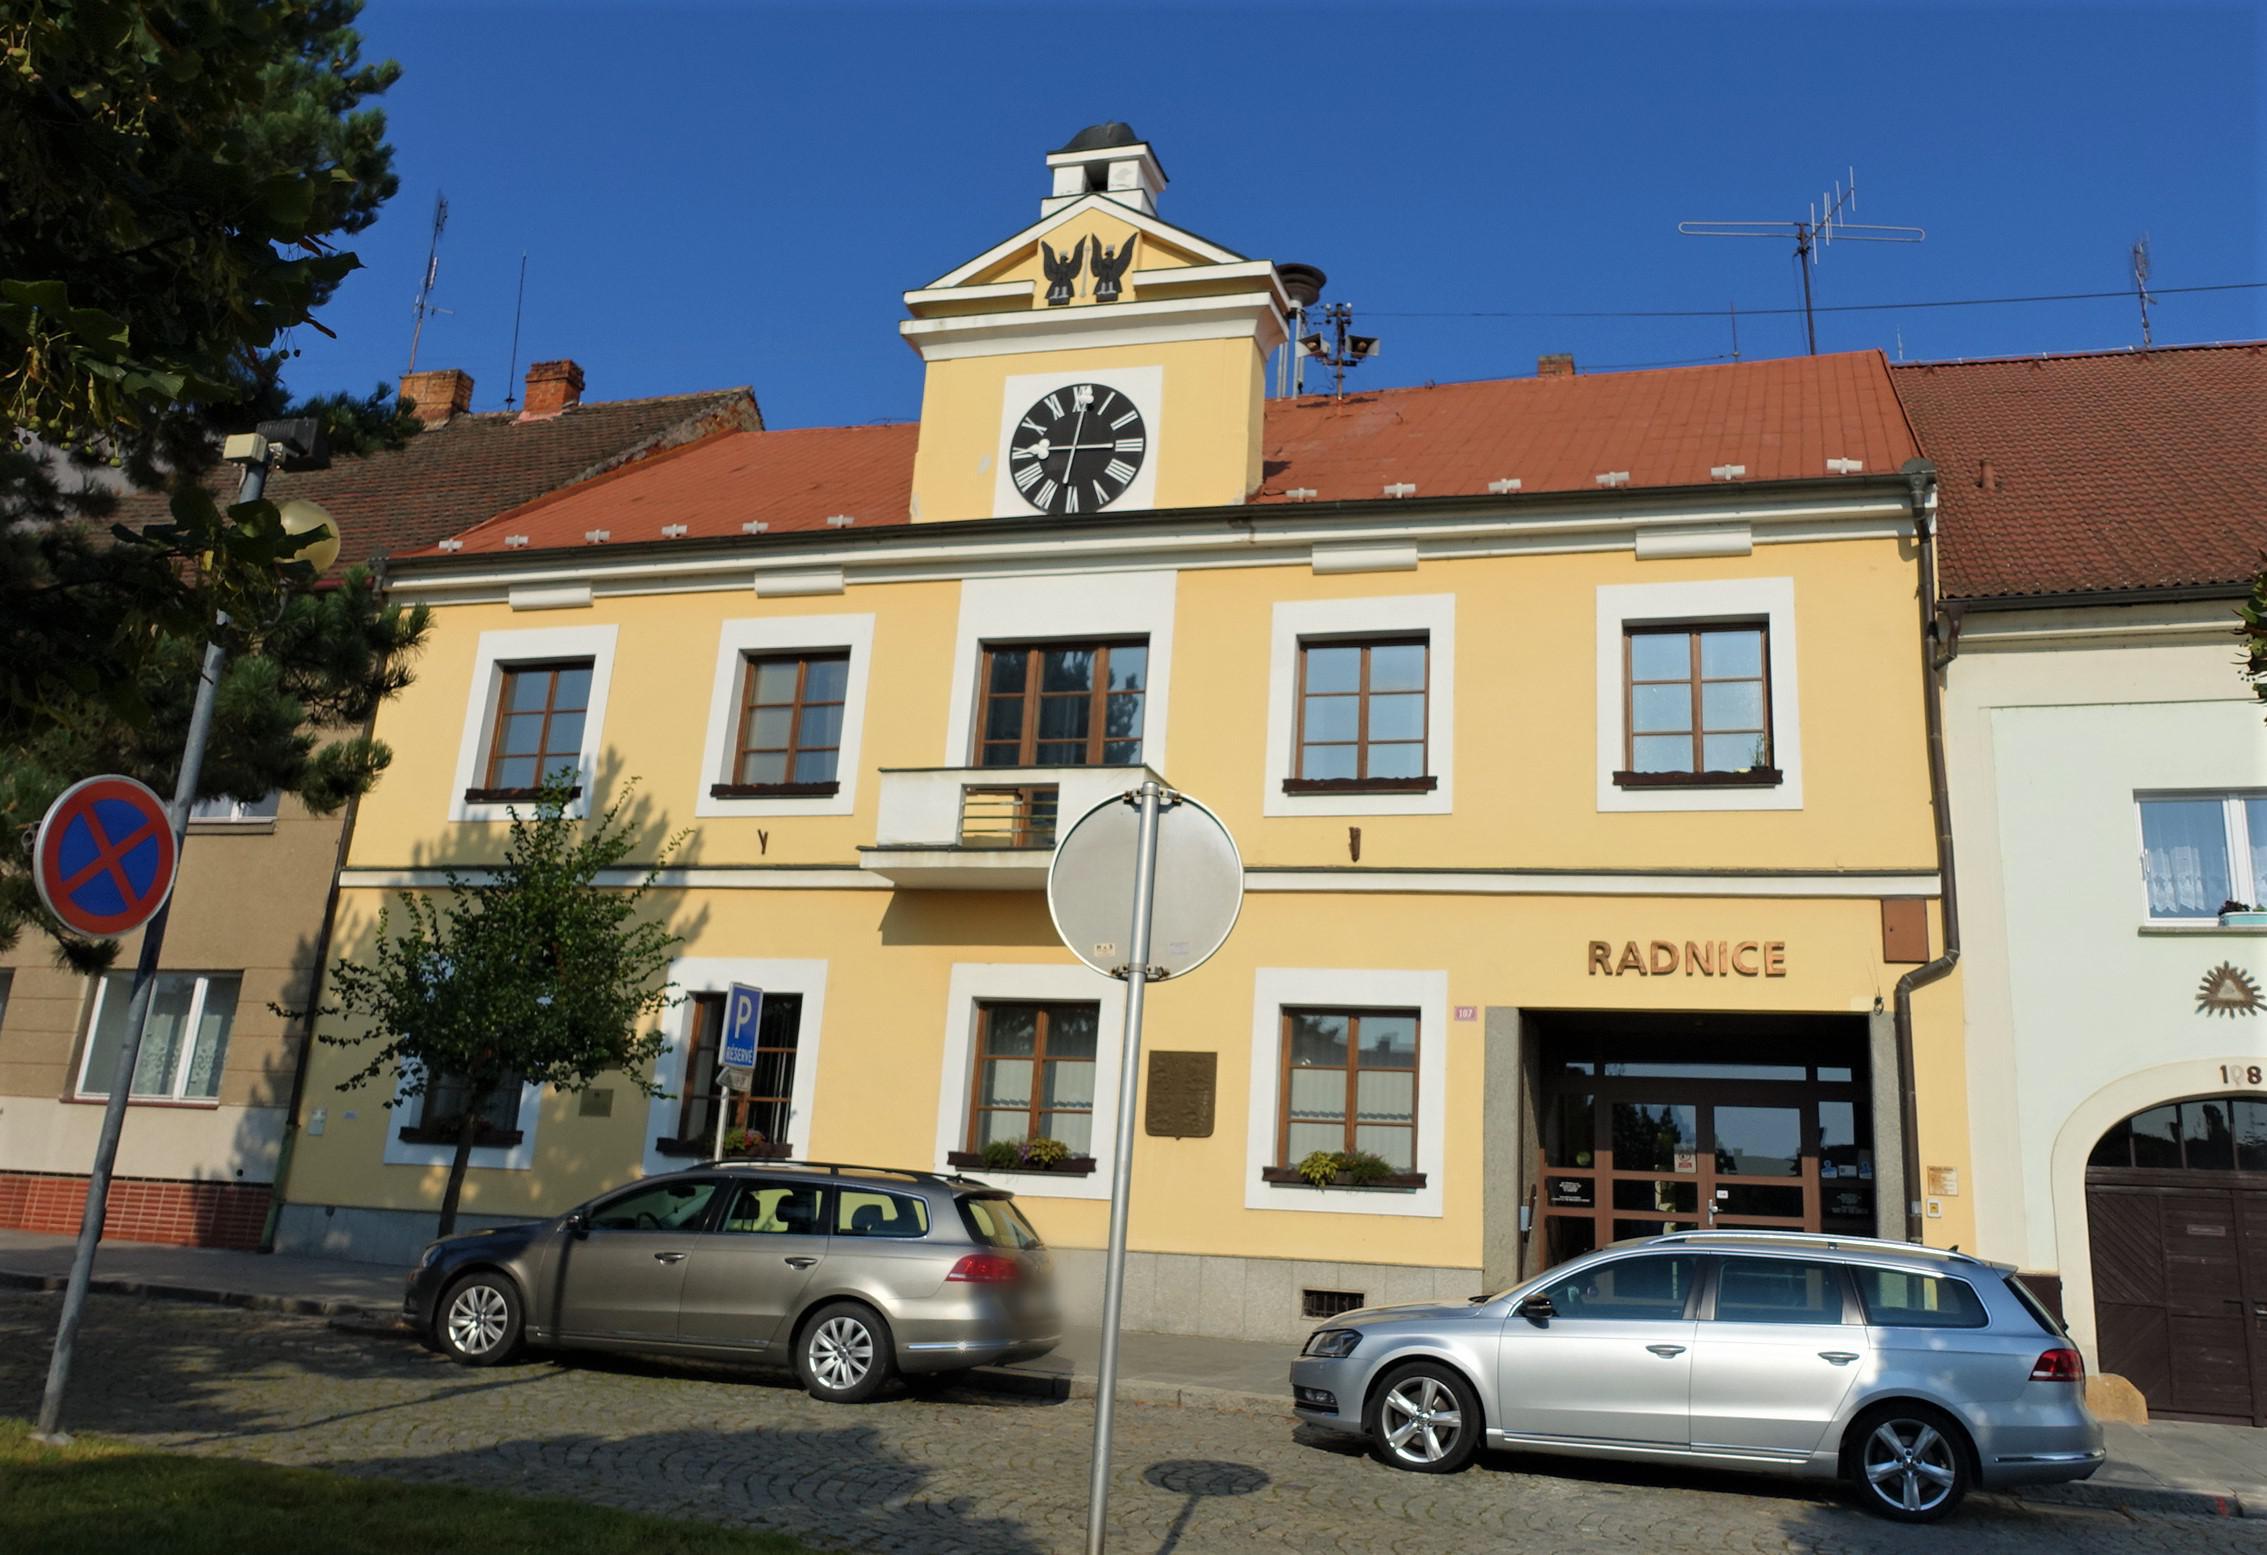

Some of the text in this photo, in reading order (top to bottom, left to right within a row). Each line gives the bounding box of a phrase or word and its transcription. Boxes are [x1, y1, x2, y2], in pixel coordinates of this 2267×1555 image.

[1044, 393, 1065, 420] XI
[1021, 416, 1047, 436] X
[1110, 410, 1138, 431] II
[1115, 438, 1143, 452] III
[1033, 479, 1058, 510] VII
[1065, 486, 1079, 513] VI
[1092, 480, 1110, 505] V
[1588, 940, 1786, 977] RADNICE
[734, 995, 752, 1039] P
